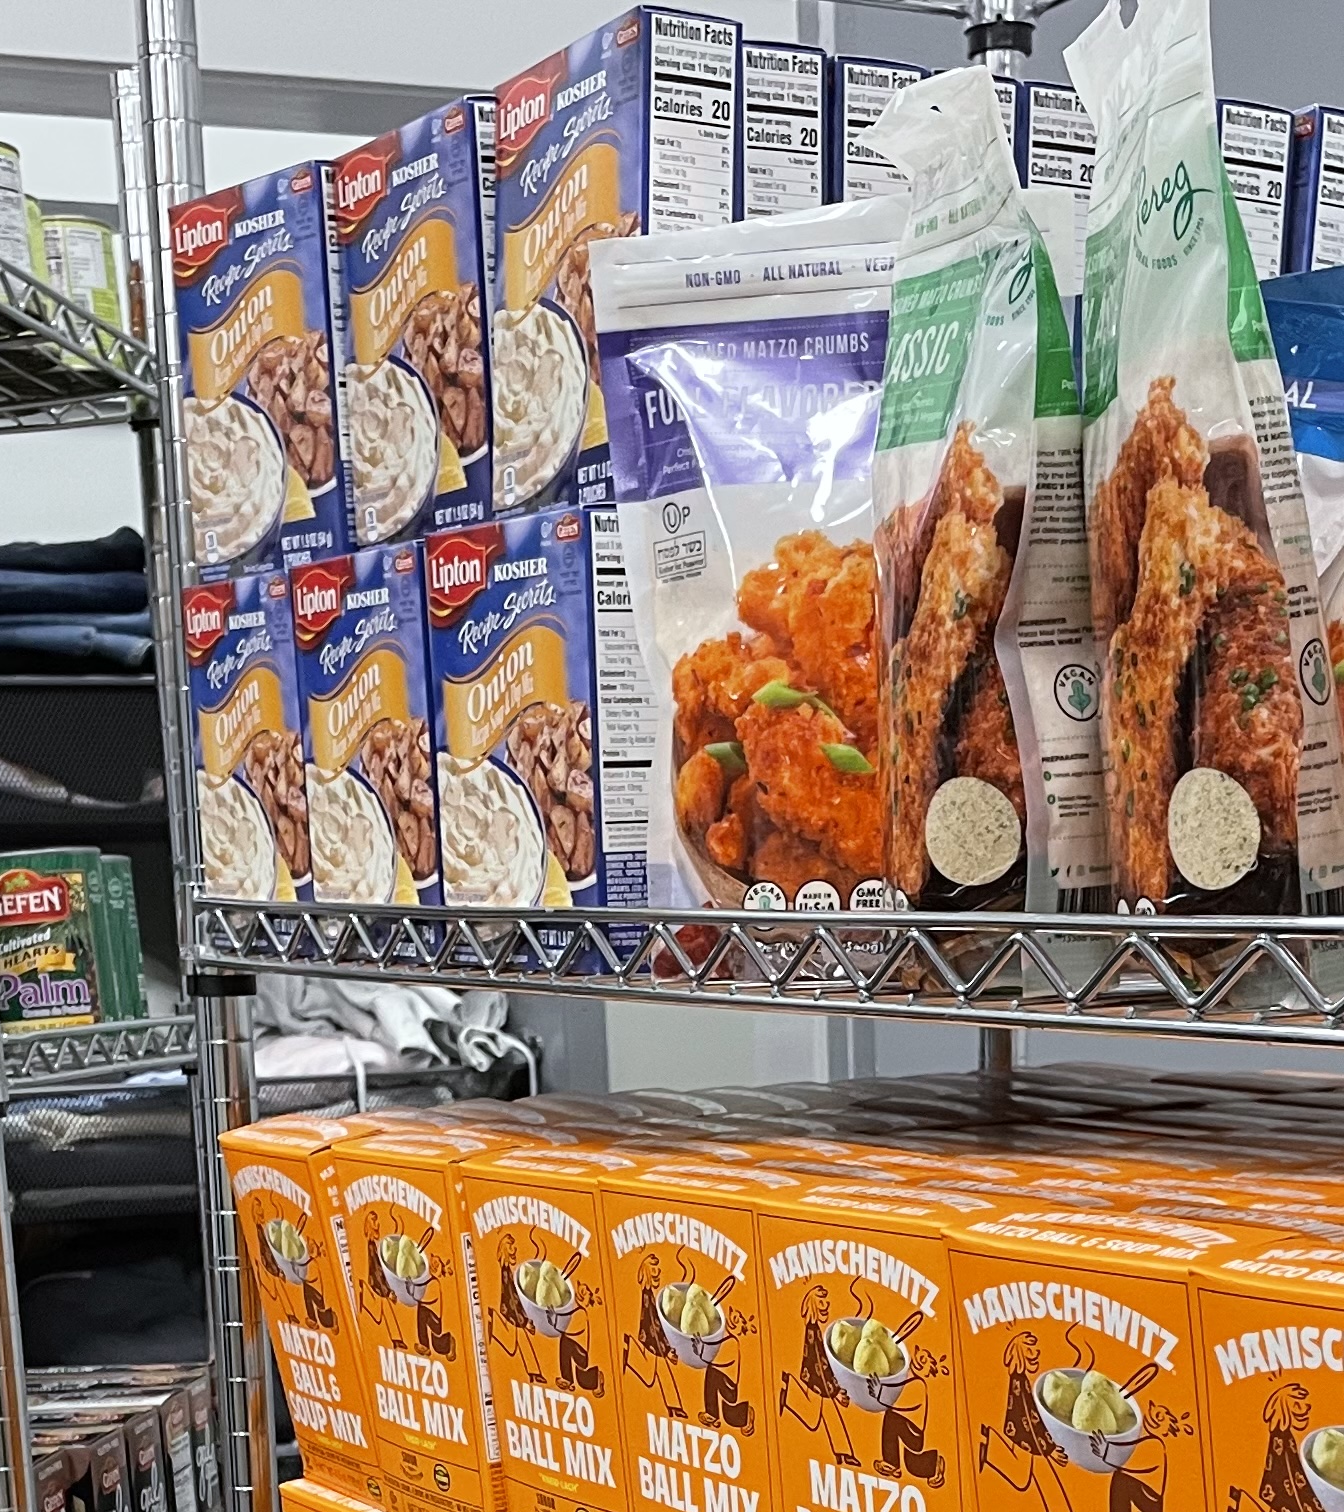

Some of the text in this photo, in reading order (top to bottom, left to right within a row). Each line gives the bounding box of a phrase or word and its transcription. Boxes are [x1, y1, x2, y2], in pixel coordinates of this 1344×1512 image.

[655, 18, 733, 46] Nutrition Facts
[746, 50, 819, 75] Nutrition Facts
[556, 70, 607, 109] KOSHER
[499, 92, 546, 139] Lipton
[655, 97, 730, 120] Calories 20
[747, 128, 818, 147] Calories 20
[175, 218, 222, 256] Lipton
[235, 210, 284, 238] KOSHER
[686, 261, 842, 288] NON-GMO ALL NATURAL
[211, 284, 273, 365] Onion
[744, 332, 869, 359] MATZO CRUMBS
[432, 555, 481, 594] Lipton
[494, 558, 547, 582] KOSHER
[468, 640, 534, 722] Onion
[748, 885, 781, 901] VEGAN
[0, 973, 89, 1010] Palm
[233, 1164, 312, 1218] MANISCHEWITZ
[473, 1195, 592, 1256] MANISCHEWITZ
[512, 1380, 595, 1438] MATZO
[505, 1425, 618, 1489] BALL MIX
